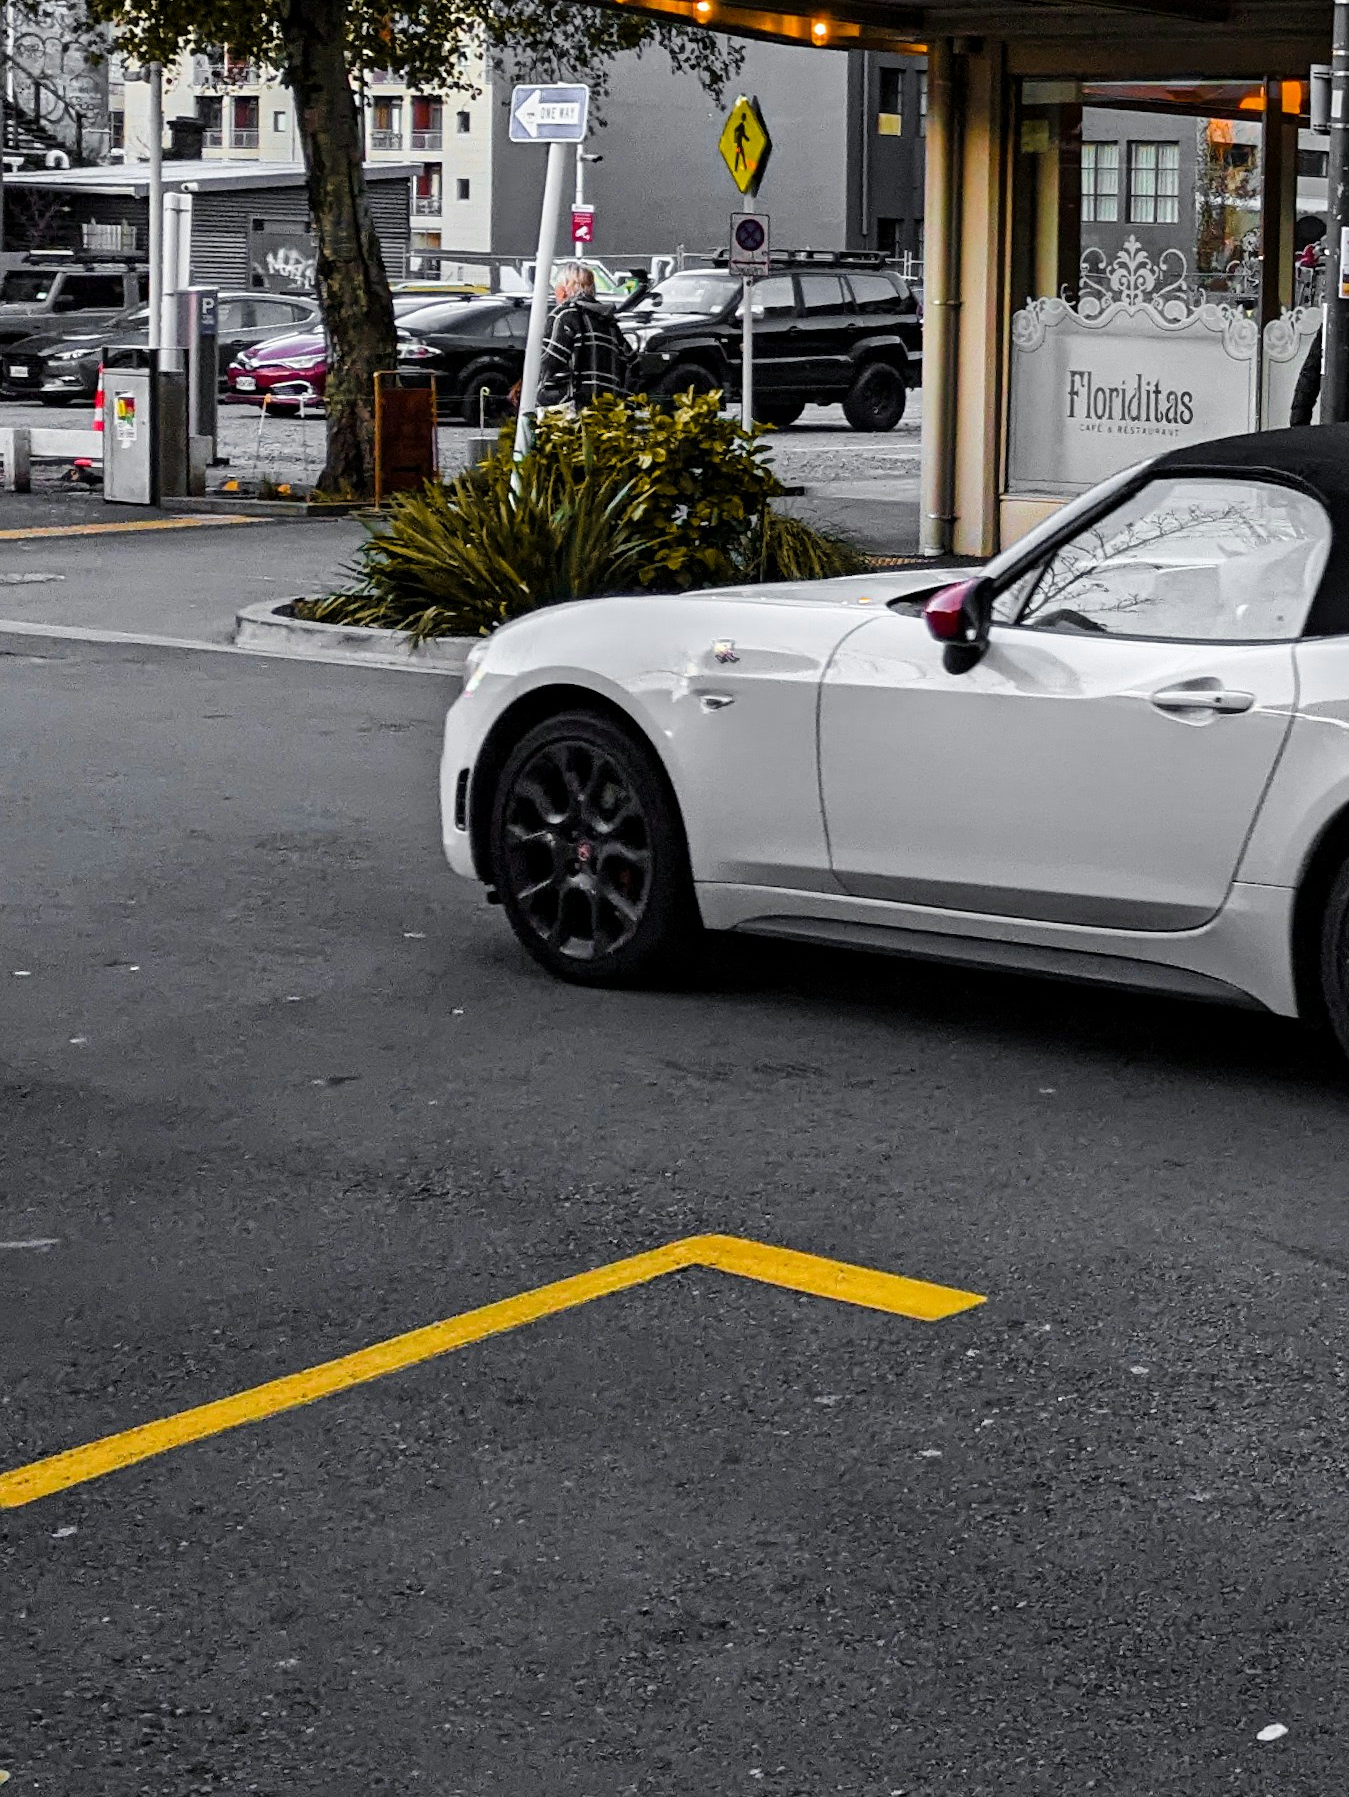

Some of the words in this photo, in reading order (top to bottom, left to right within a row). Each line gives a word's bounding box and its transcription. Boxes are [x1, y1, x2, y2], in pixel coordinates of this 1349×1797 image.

[540, 106, 557, 120] ONE
[559, 107, 575, 120] WAY
[202, 297, 215, 314] P
[1066, 370, 1194, 425] Floriditas
[1117, 425, 1180, 437] RESTAURANT
